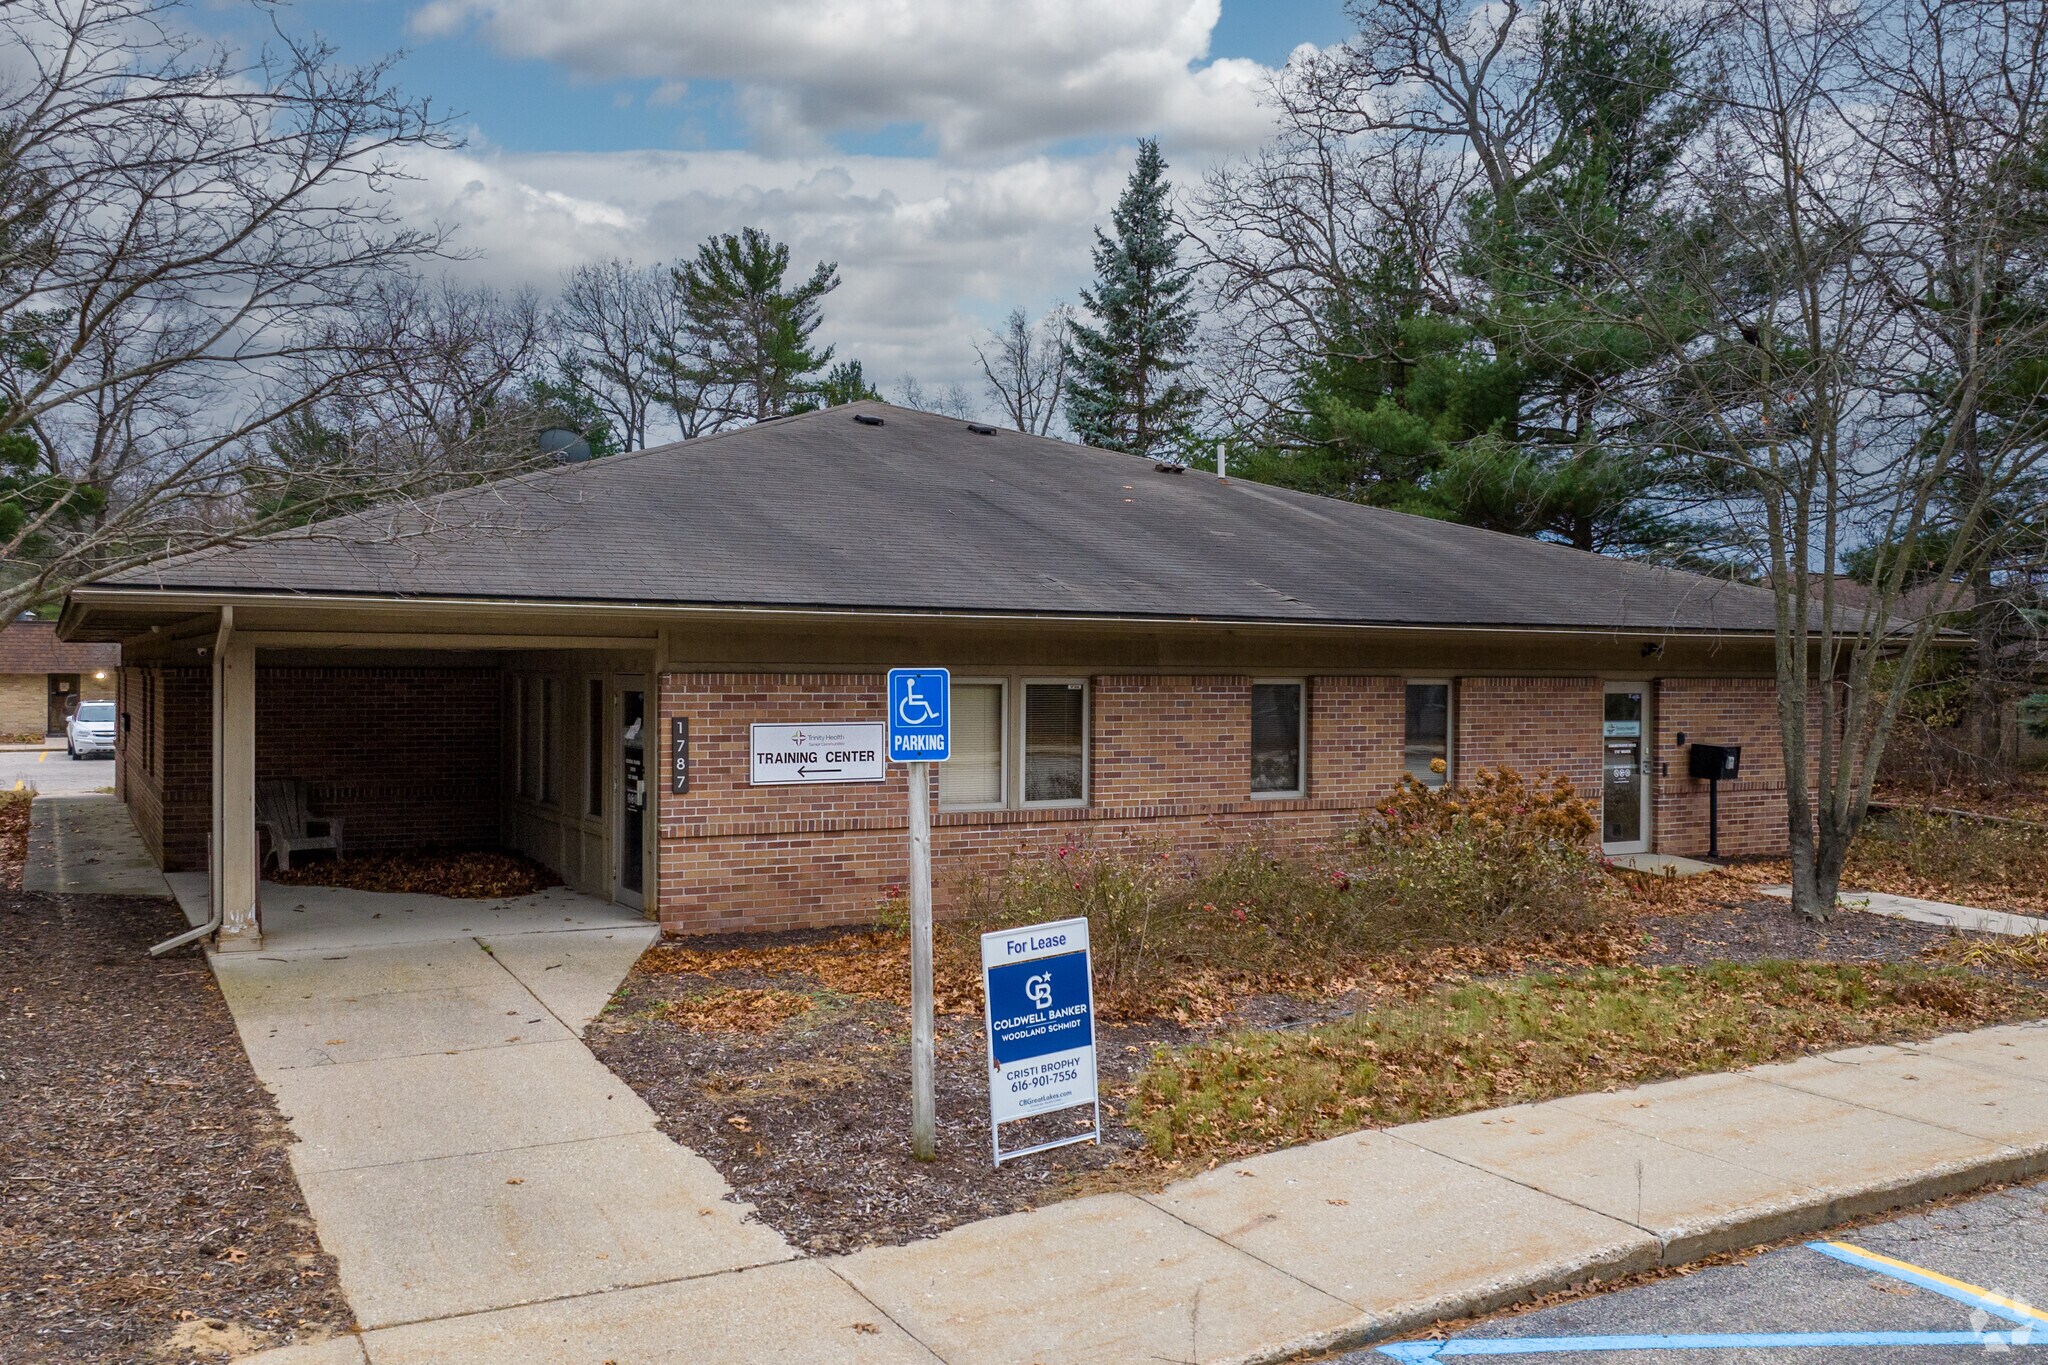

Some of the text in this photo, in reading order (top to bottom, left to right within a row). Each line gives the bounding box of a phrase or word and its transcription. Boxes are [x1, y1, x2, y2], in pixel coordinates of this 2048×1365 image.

[895, 735, 945, 751] PARKING
[676, 722, 686, 788] 1787
[757, 750, 875, 764] TRAINING CENTER
[1007, 934, 1066, 955] For Lease
[993, 1004, 1087, 1031] COLDWELL BANKER
[1002, 1019, 1081, 1042] WOODLAND SCHMIDT
[1006, 1057, 1081, 1081] CRISTI BROPHY
[1011, 1069, 1078, 1093] 616-901-7556
